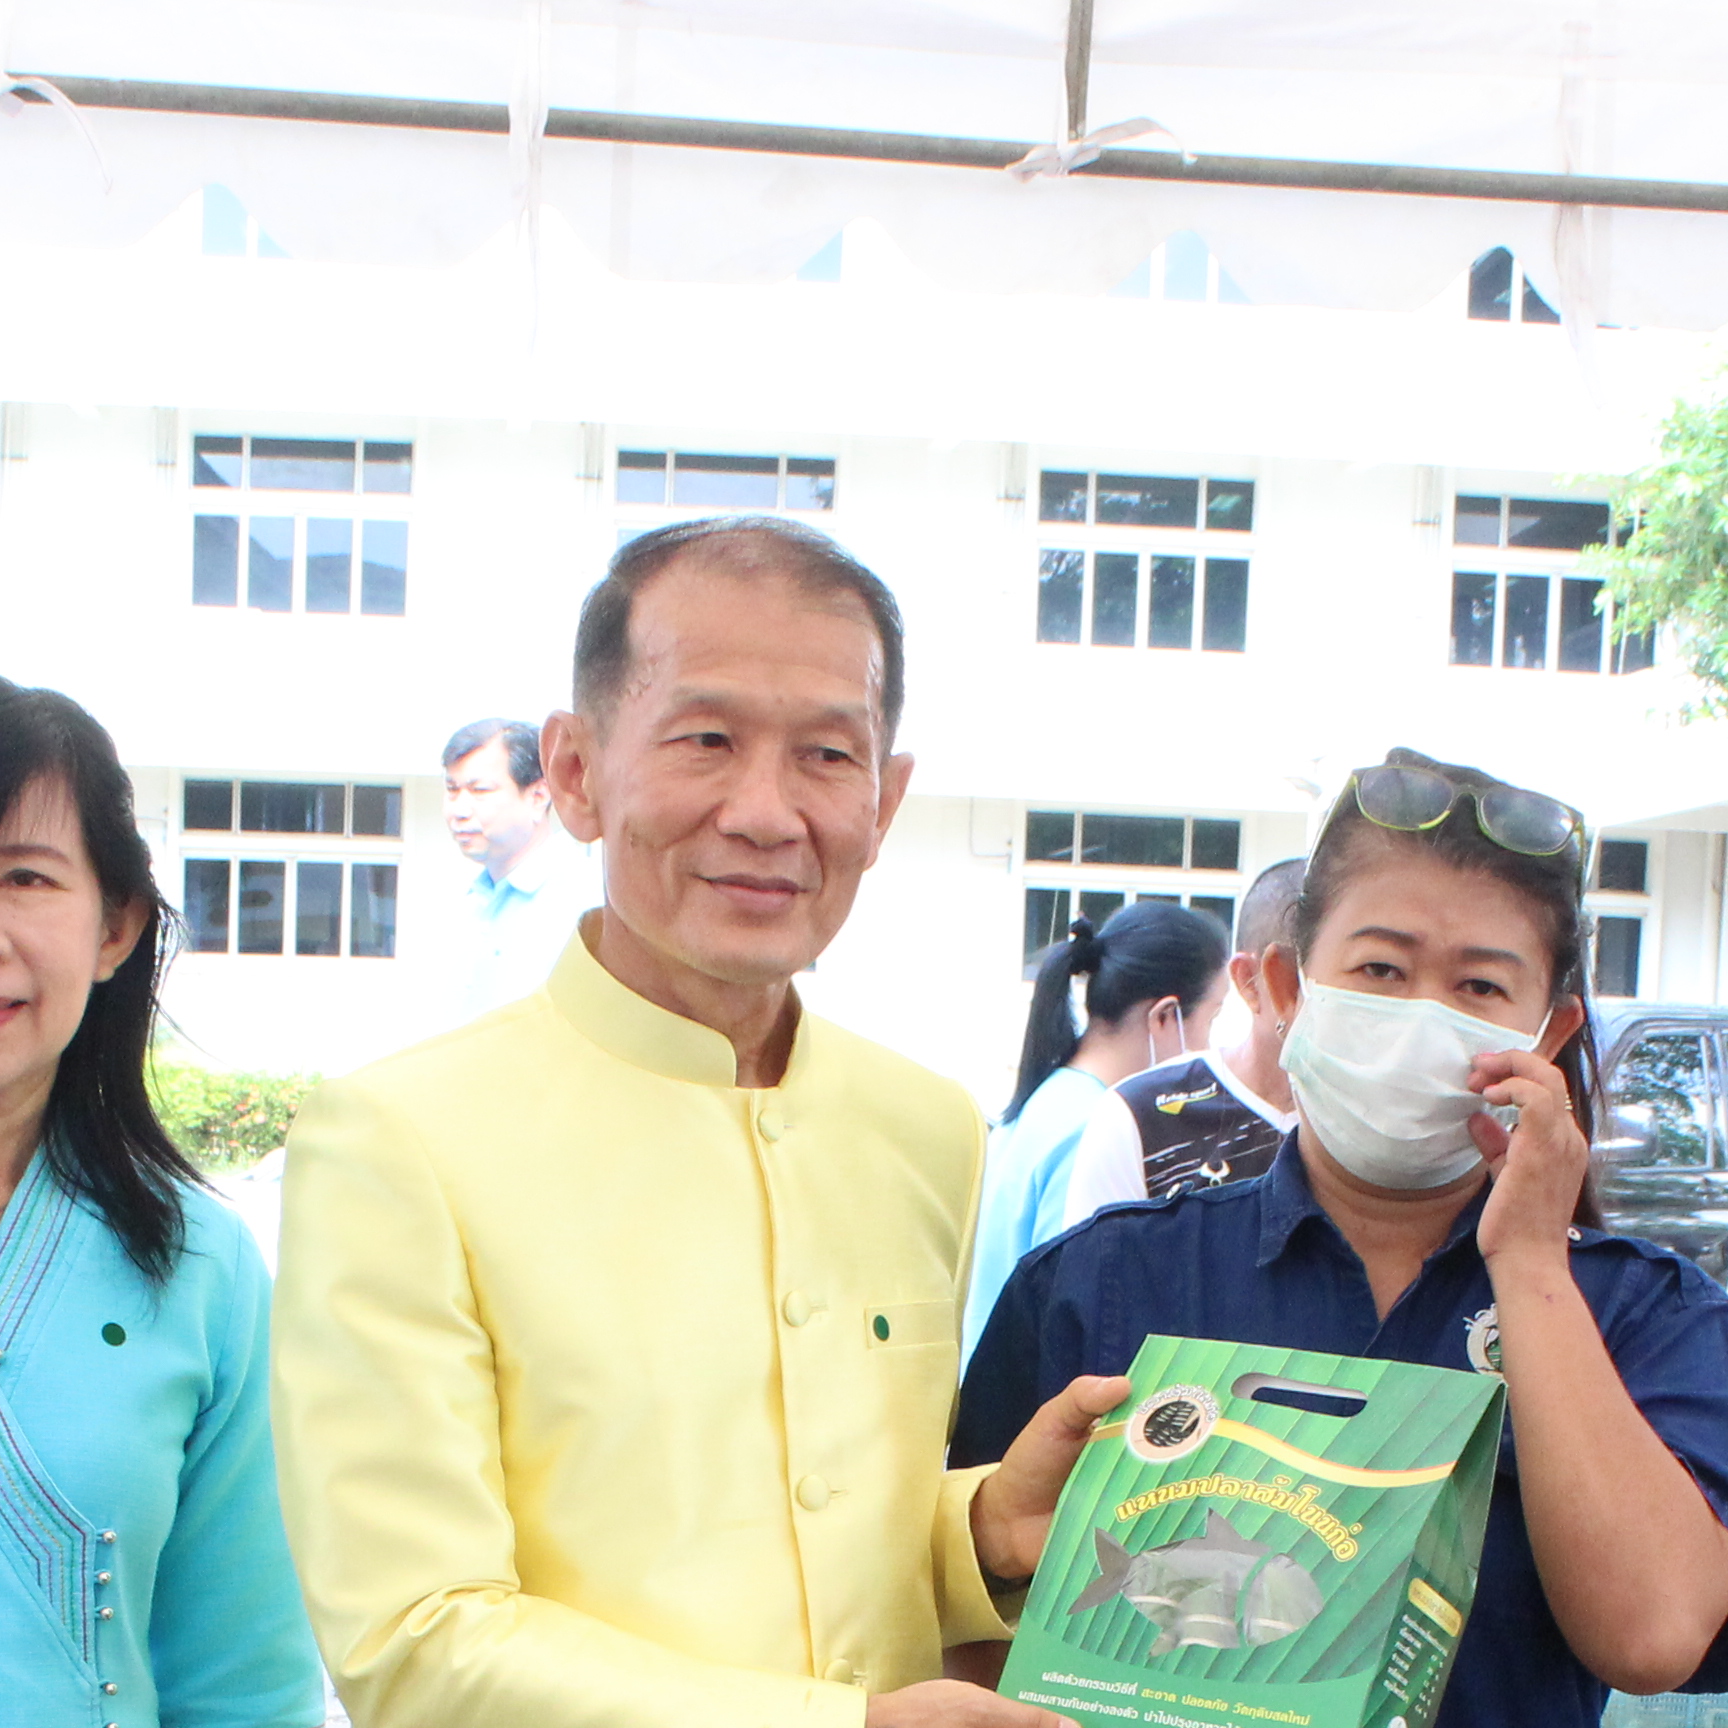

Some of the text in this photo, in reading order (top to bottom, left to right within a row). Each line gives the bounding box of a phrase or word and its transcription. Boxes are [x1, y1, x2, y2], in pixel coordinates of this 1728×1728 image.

[1115, 1473, 1362, 1562] แหนมปลาส้มโนนก่อ
[1141, 1686, 1177, 1703] สะอาด
[1182, 1694, 1228, 1711] ปลอดภัย
